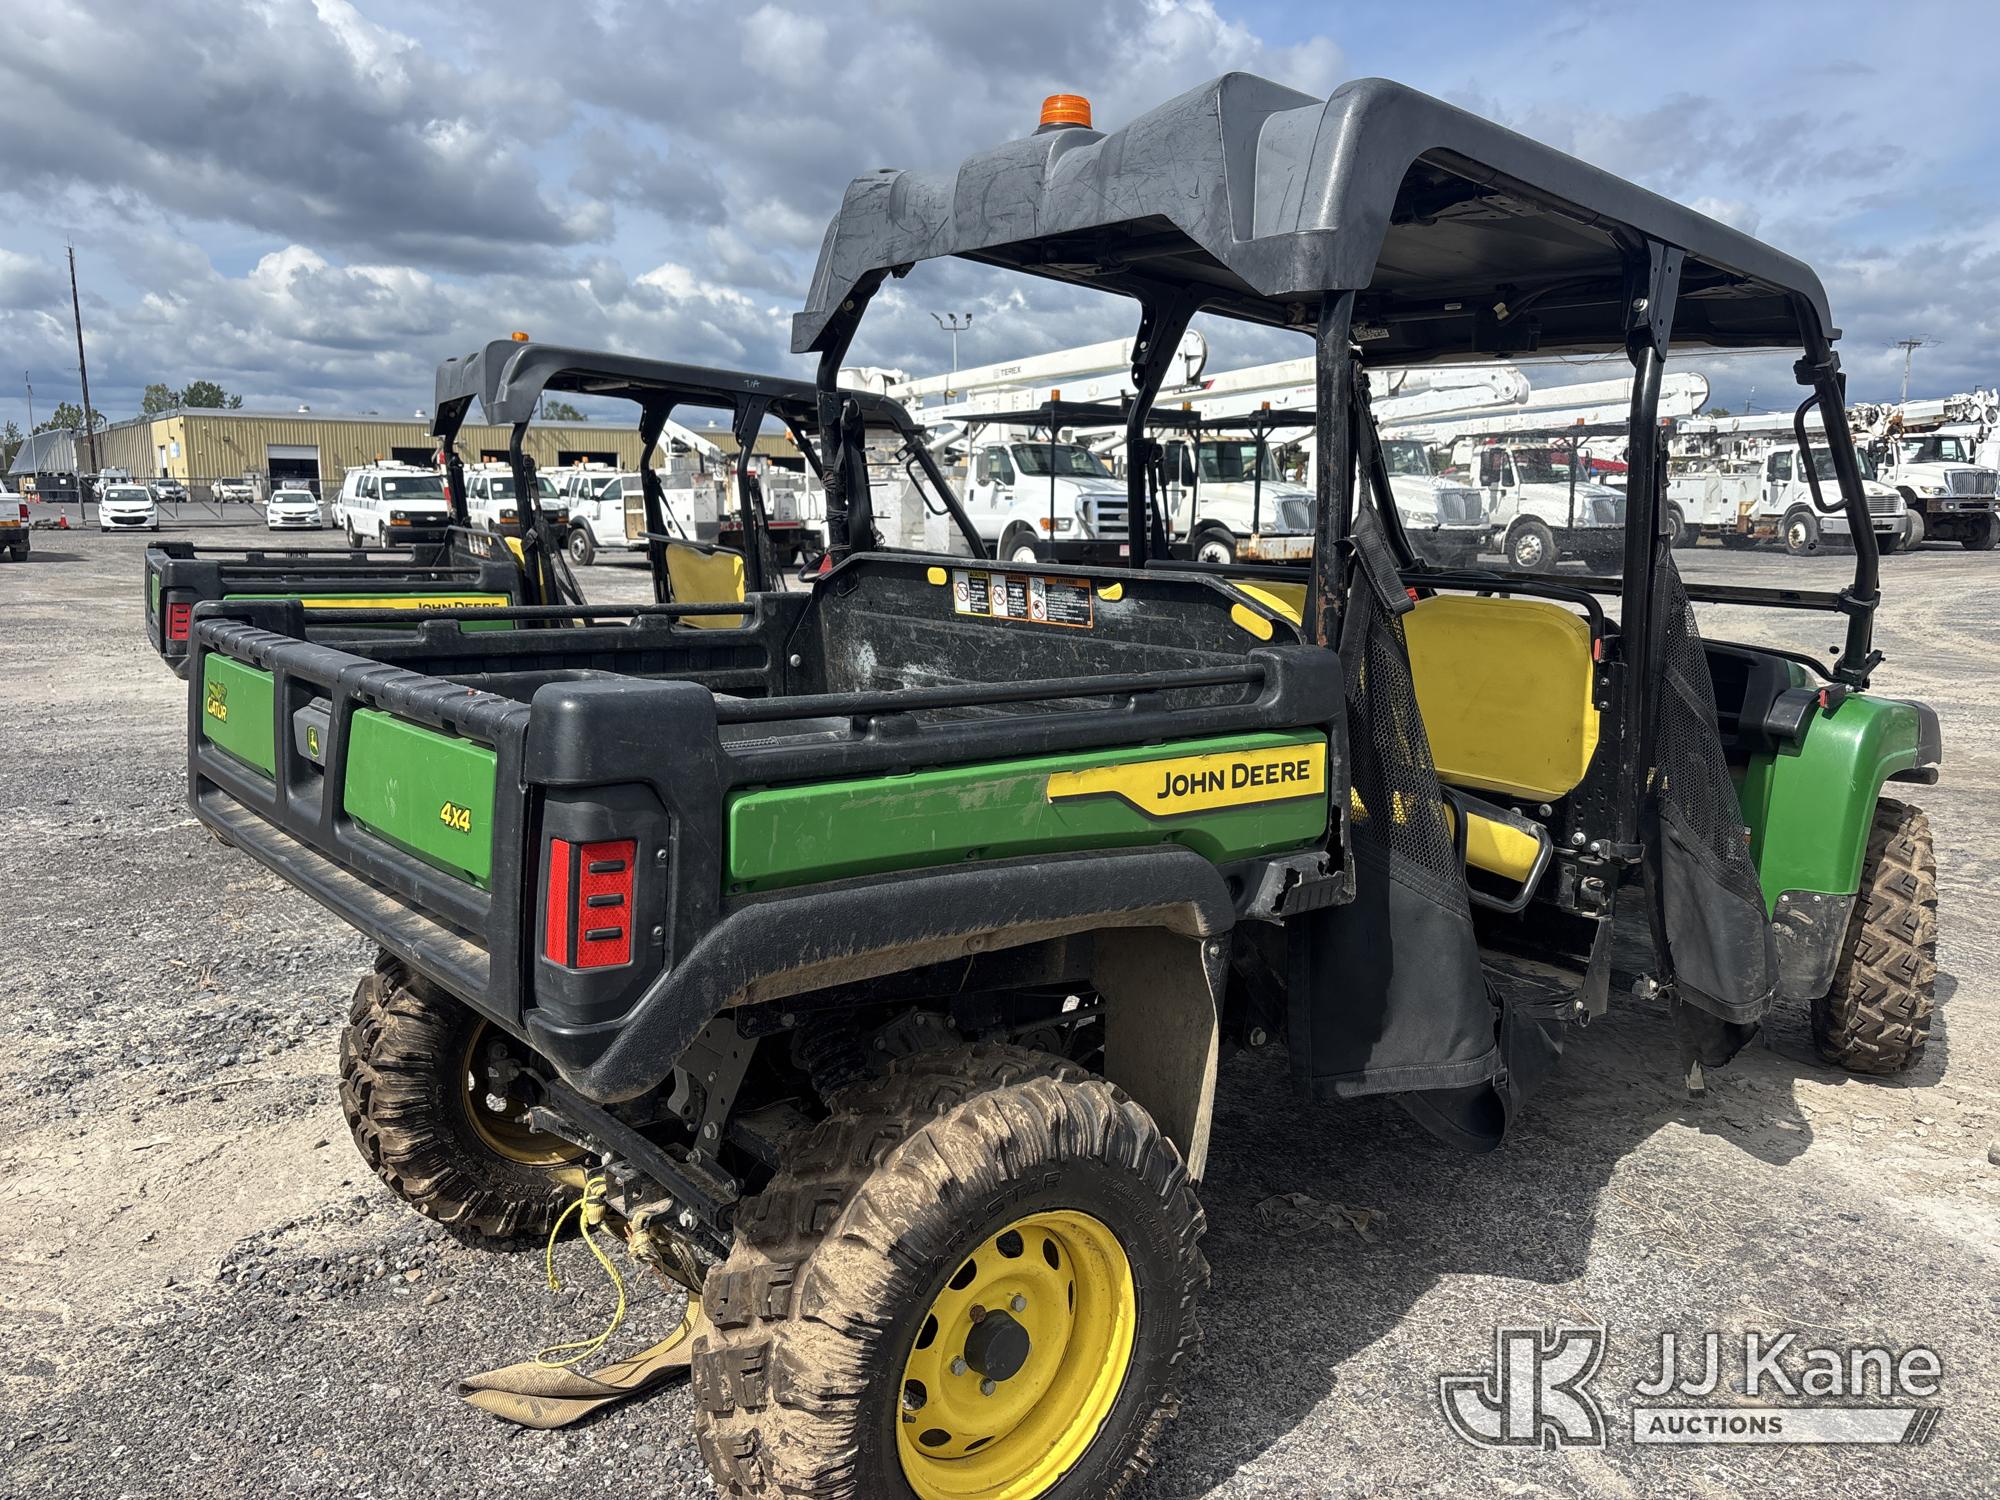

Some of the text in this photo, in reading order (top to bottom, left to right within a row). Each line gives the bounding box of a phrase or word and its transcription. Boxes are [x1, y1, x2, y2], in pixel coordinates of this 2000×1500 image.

[1000, 366, 1021, 376] TEREX
[207, 696, 227, 721] GATOR
[1157, 759, 1310, 799] JOHN DEERE
